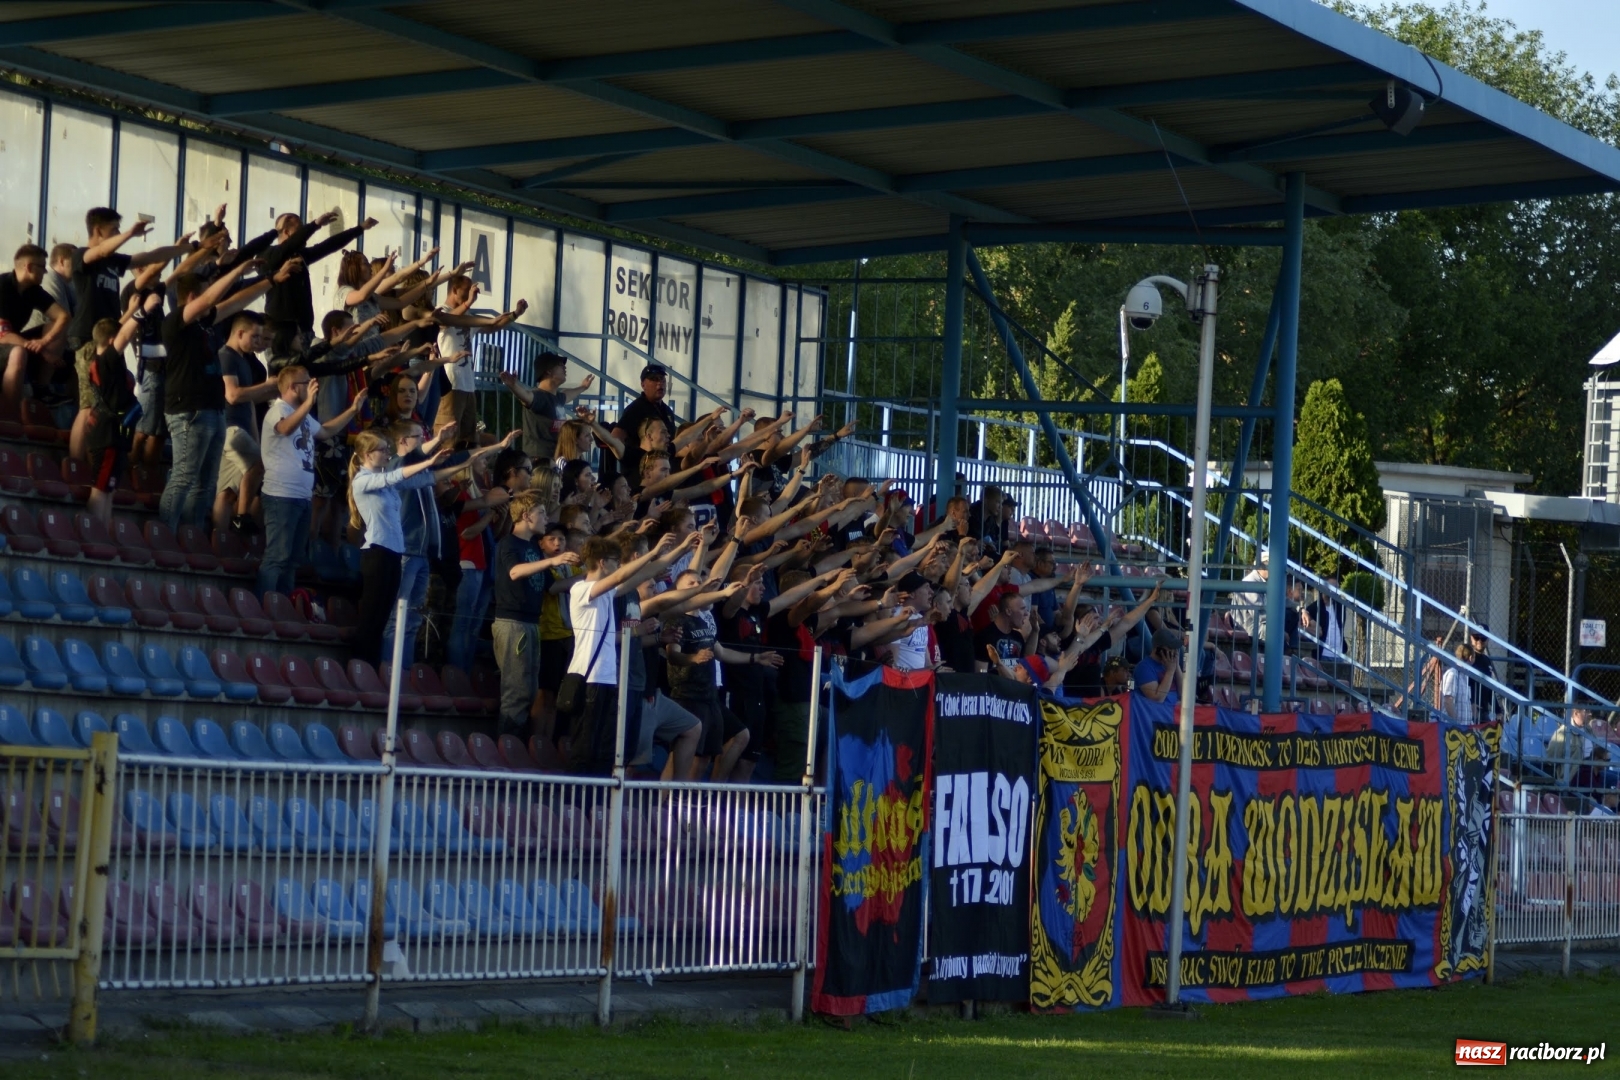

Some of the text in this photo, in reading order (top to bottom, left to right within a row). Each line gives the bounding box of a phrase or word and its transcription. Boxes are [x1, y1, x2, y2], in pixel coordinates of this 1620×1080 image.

[471, 234, 492, 293] A
[616, 266, 691, 311] SEKTOR
[1143, 302, 1150, 310] 6
[608, 308, 693, 355] RODZNNY
[1277, 738, 1293, 767] TO
[1379, 738, 1390, 763] W
[1393, 742, 1420, 770] CENIE
[1245, 958, 1276, 984] KLUB
[1280, 952, 1296, 980] TO
[1300, 949, 1325, 978] TWE
